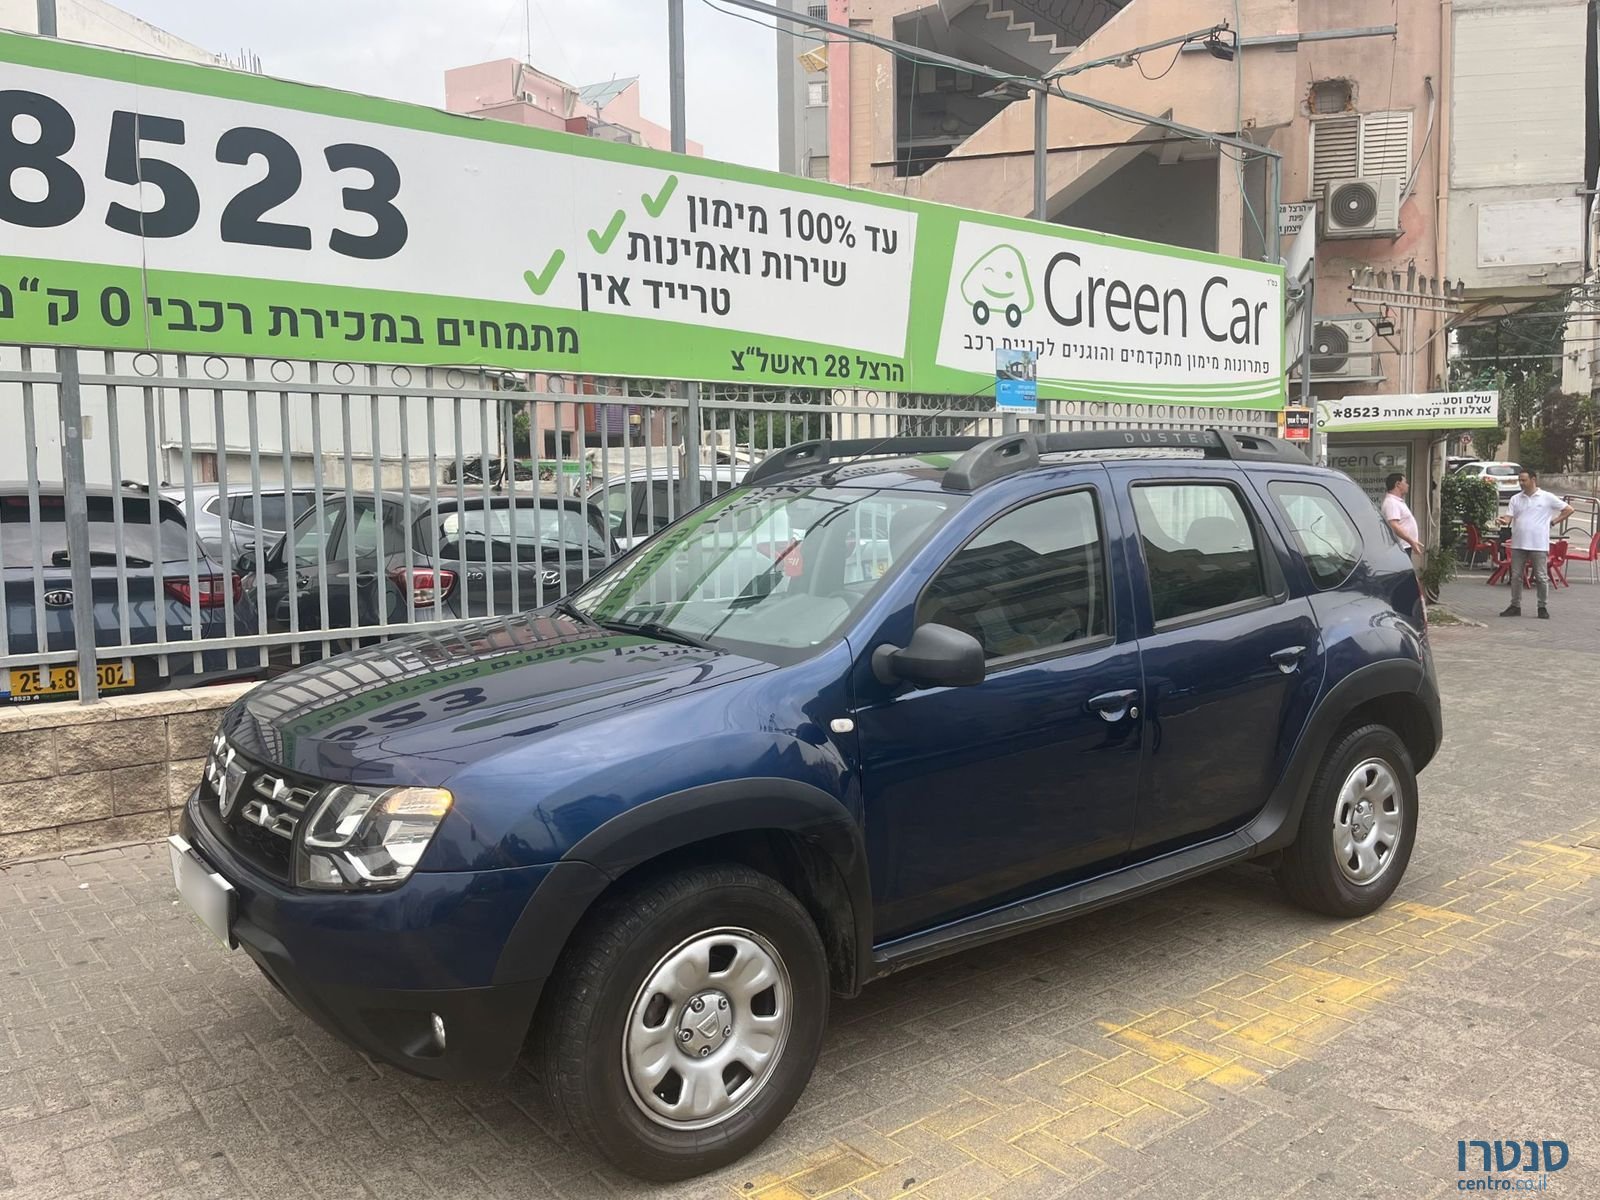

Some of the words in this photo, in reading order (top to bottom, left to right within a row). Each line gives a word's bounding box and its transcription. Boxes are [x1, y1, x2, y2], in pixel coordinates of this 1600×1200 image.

[687, 195, 768, 234] מימון
[1288, 214, 1304, 222] פינת
[1289, 204, 1307, 213] הרצל
[779, 207, 856, 248] 100%
[864, 225, 898, 254] עד
[627, 231, 751, 275] ואמינות
[762, 251, 847, 287] שירות
[578, 272, 631, 312] אין
[643, 279, 731, 316] טרייד
[1044, 251, 1187, 338] Green
[1200, 276, 1267, 346] Car
[100, 286, 131, 327] 0
[147, 296, 253, 335] רכבי
[268, 305, 424, 345] במכירת
[436, 317, 580, 354] מתמחים
[963, 334, 994, 351] רכב
[1062, 344, 1114, 361] והוגנים
[731, 346, 818, 377] ראשל"צ
[824, 354, 850, 378] 28
[856, 356, 904, 382] הרצל
[1120, 348, 1182, 367] מתקדמים
[1187, 354, 1219, 372] מימון
[1224, 357, 1270, 374] פתרונות
[1443, 406, 1456, 415] זה
[1459, 405, 1491, 415] אצלנו
[1466, 395, 1492, 404] שלם
[1383, 408, 1413, 417] אחרת
[1416, 407, 1440, 418] קצת
[1124, 432, 1214, 444] DUSTER
[48, 593, 73, 603] KIA
